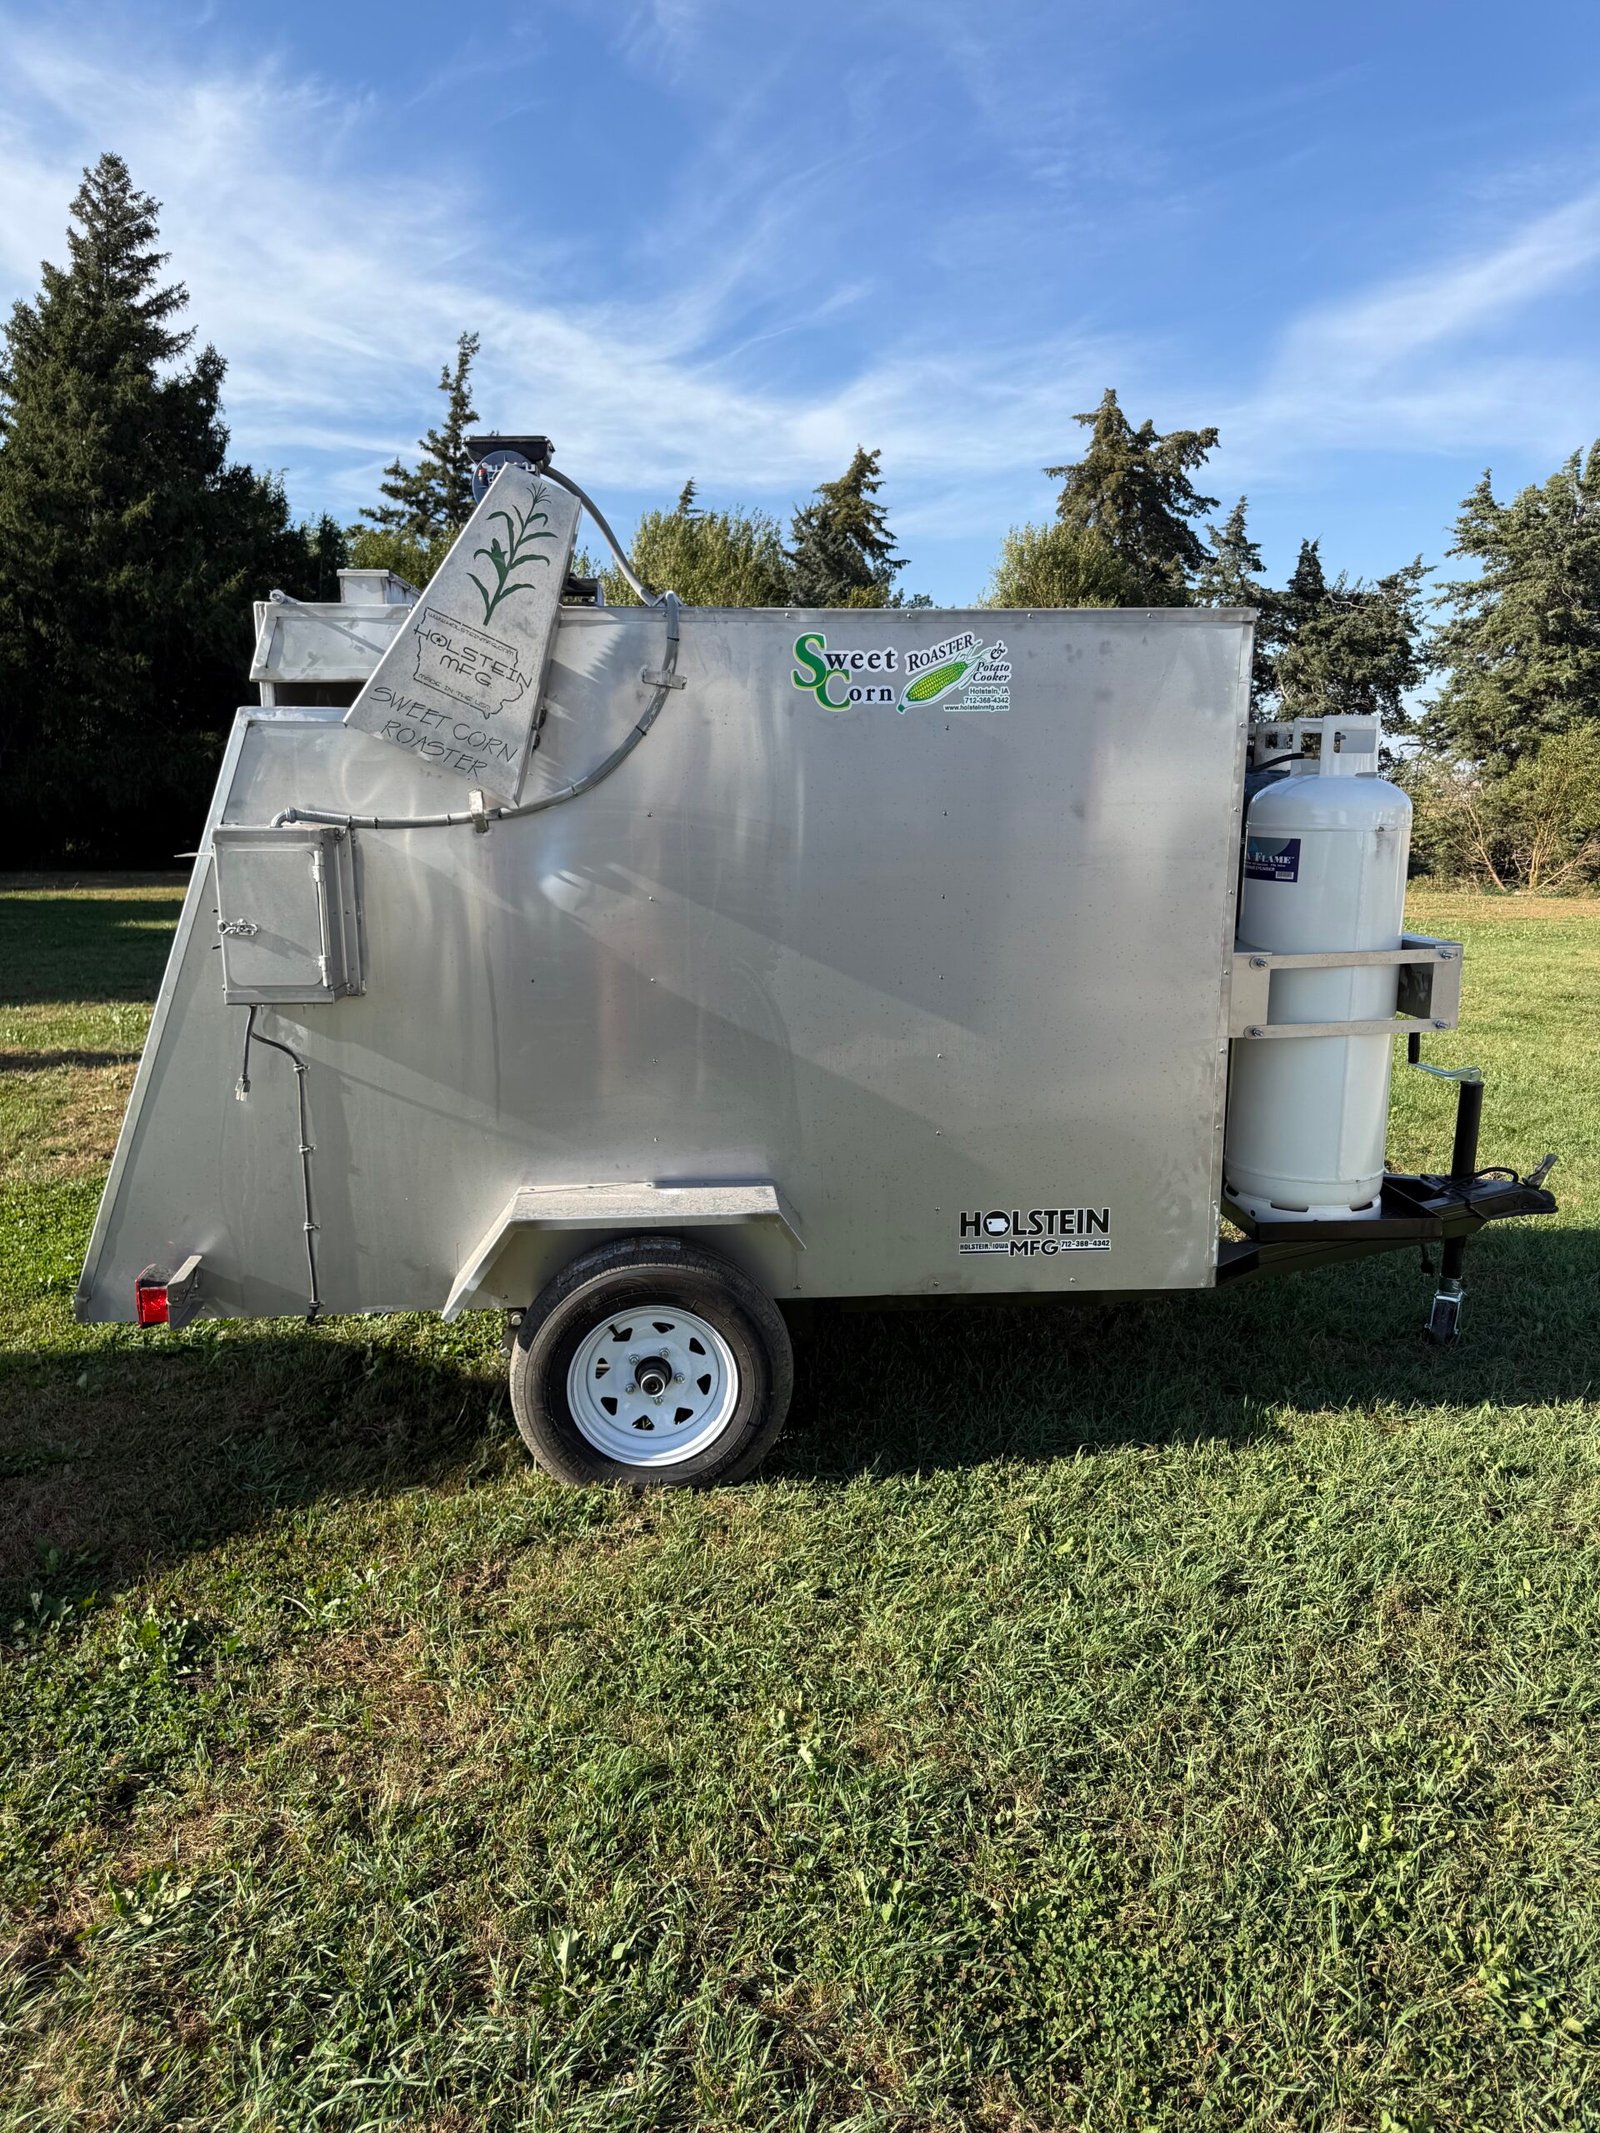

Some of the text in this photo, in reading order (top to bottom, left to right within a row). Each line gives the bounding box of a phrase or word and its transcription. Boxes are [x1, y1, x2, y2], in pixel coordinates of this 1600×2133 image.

[413, 624, 533, 688] HOLSTEIN
[907, 634, 974, 673] ROASTER
[990, 642, 1006, 660] &
[793, 633, 896, 688] Sweet
[976, 661, 1010, 672] Potato
[972, 671, 1010, 682] Cooker
[444, 685, 454, 694] IN
[456, 690, 473, 701] THE
[815, 668, 893, 709] Corn
[944, 704, 1010, 712] www.holsteinmfg.com
[965, 696, 1010, 704] 712-368-4342
[370, 686, 518, 762] SWEET CORN
[381, 719, 488, 777] ROASTER
[959, 1208, 1110, 1237] HOLSTEIN
[1009, 1239, 1059, 1256] MFG
[1061, 1239, 1110, 1248] 712-368-4342
